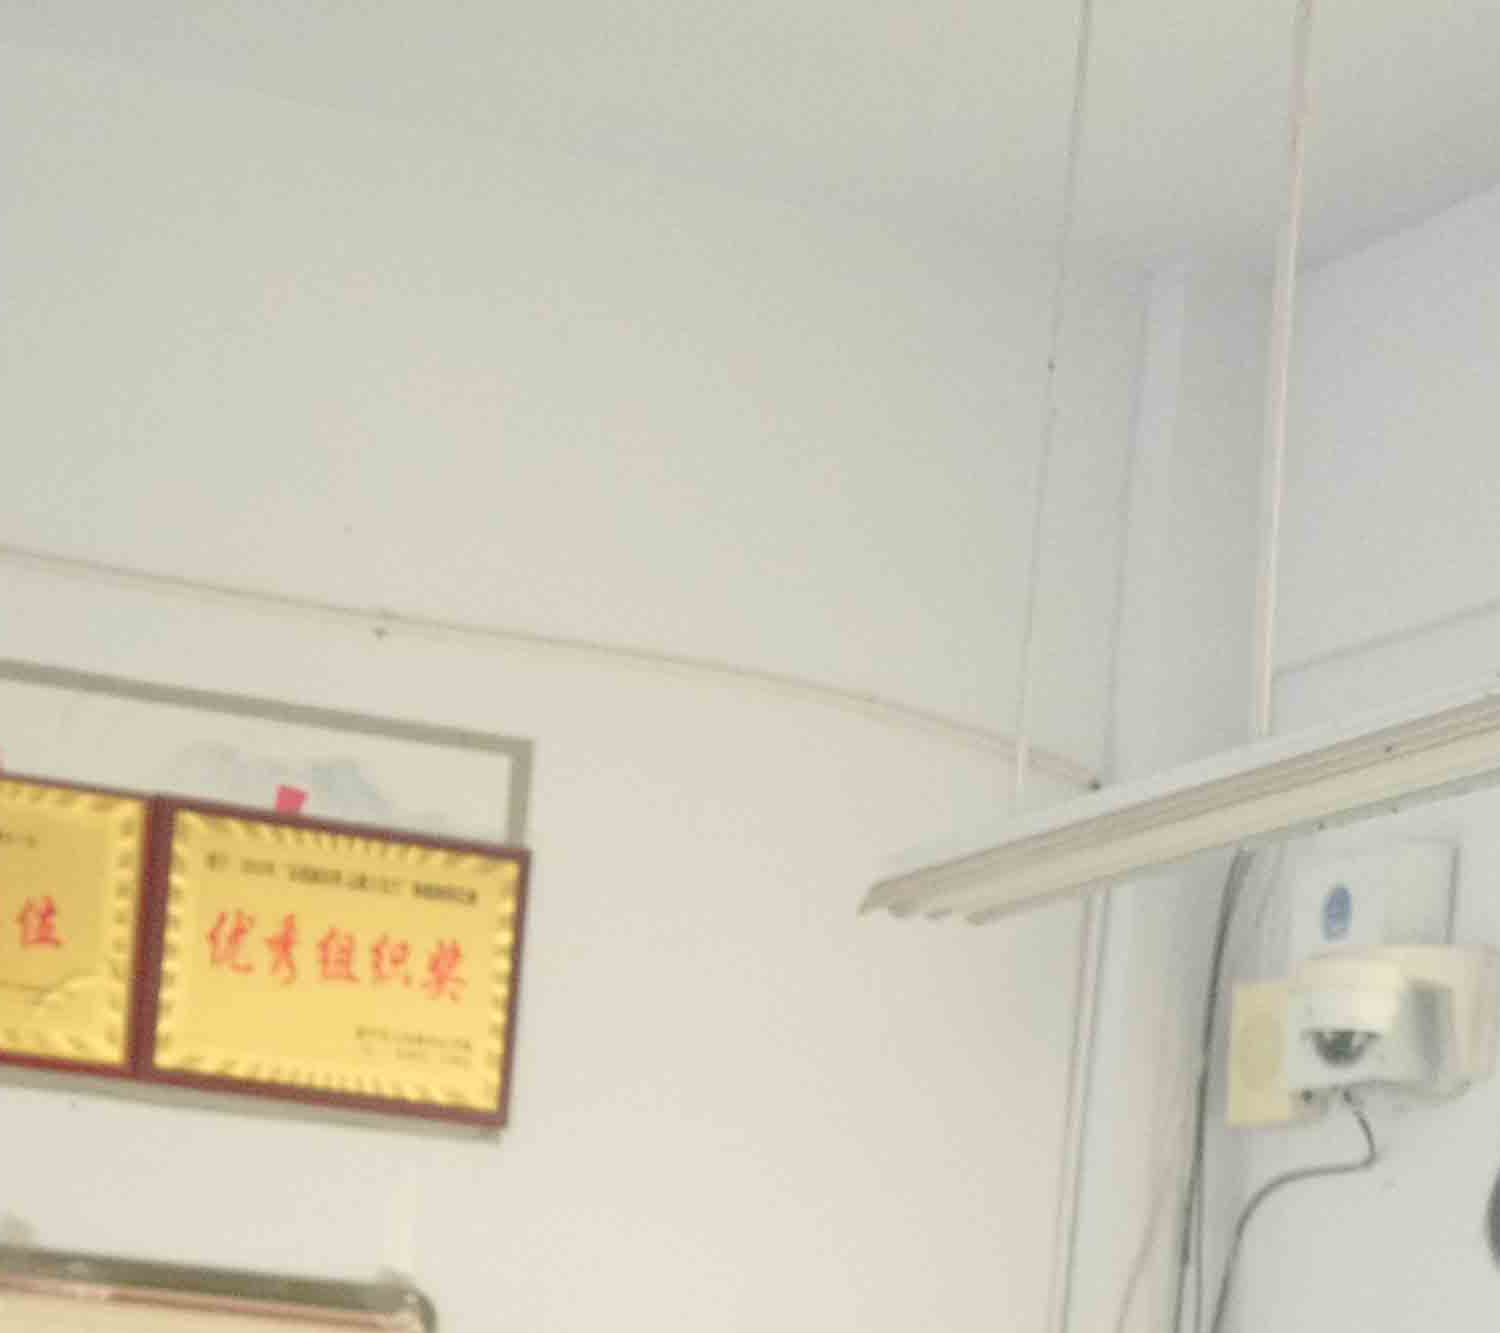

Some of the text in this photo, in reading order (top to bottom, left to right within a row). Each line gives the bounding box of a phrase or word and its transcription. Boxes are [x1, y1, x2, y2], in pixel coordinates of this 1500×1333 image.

[206, 908, 468, 1004] 优秀组织奖
